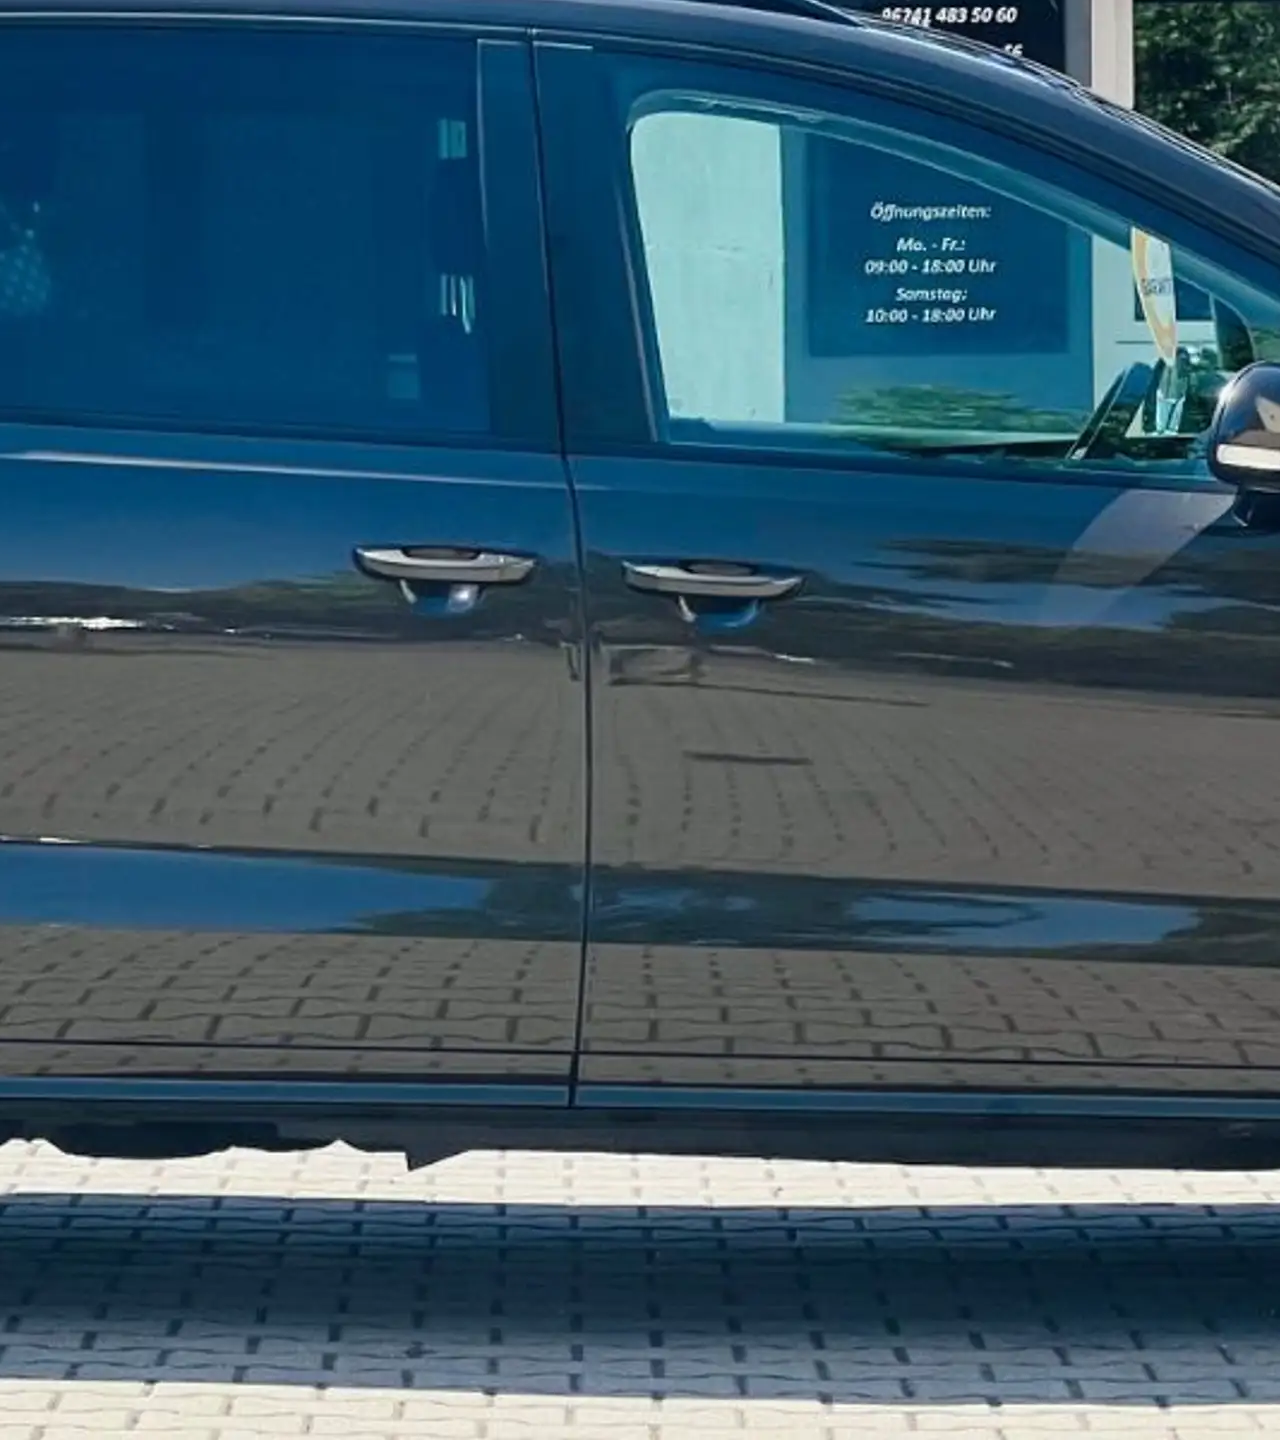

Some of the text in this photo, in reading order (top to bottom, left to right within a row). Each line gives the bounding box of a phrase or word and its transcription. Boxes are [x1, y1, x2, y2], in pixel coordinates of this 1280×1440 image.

[935, 7, 968, 23] 483
[971, 7, 993, 23] 50
[995, 7, 1018, 23] 60
[870, 201, 991, 222] Öffnungszeiten:
[896, 237, 926, 252] Mo.
[865, 259, 908, 274] 09:00
[921, 259, 966, 274] 18:00
[968, 258, 997, 273] Uhr
[895, 287, 968, 303] Samstag:
[865, 308, 908, 323] 10:00
[921, 308, 966, 323] 18:00
[968, 307, 997, 322] Uhr
